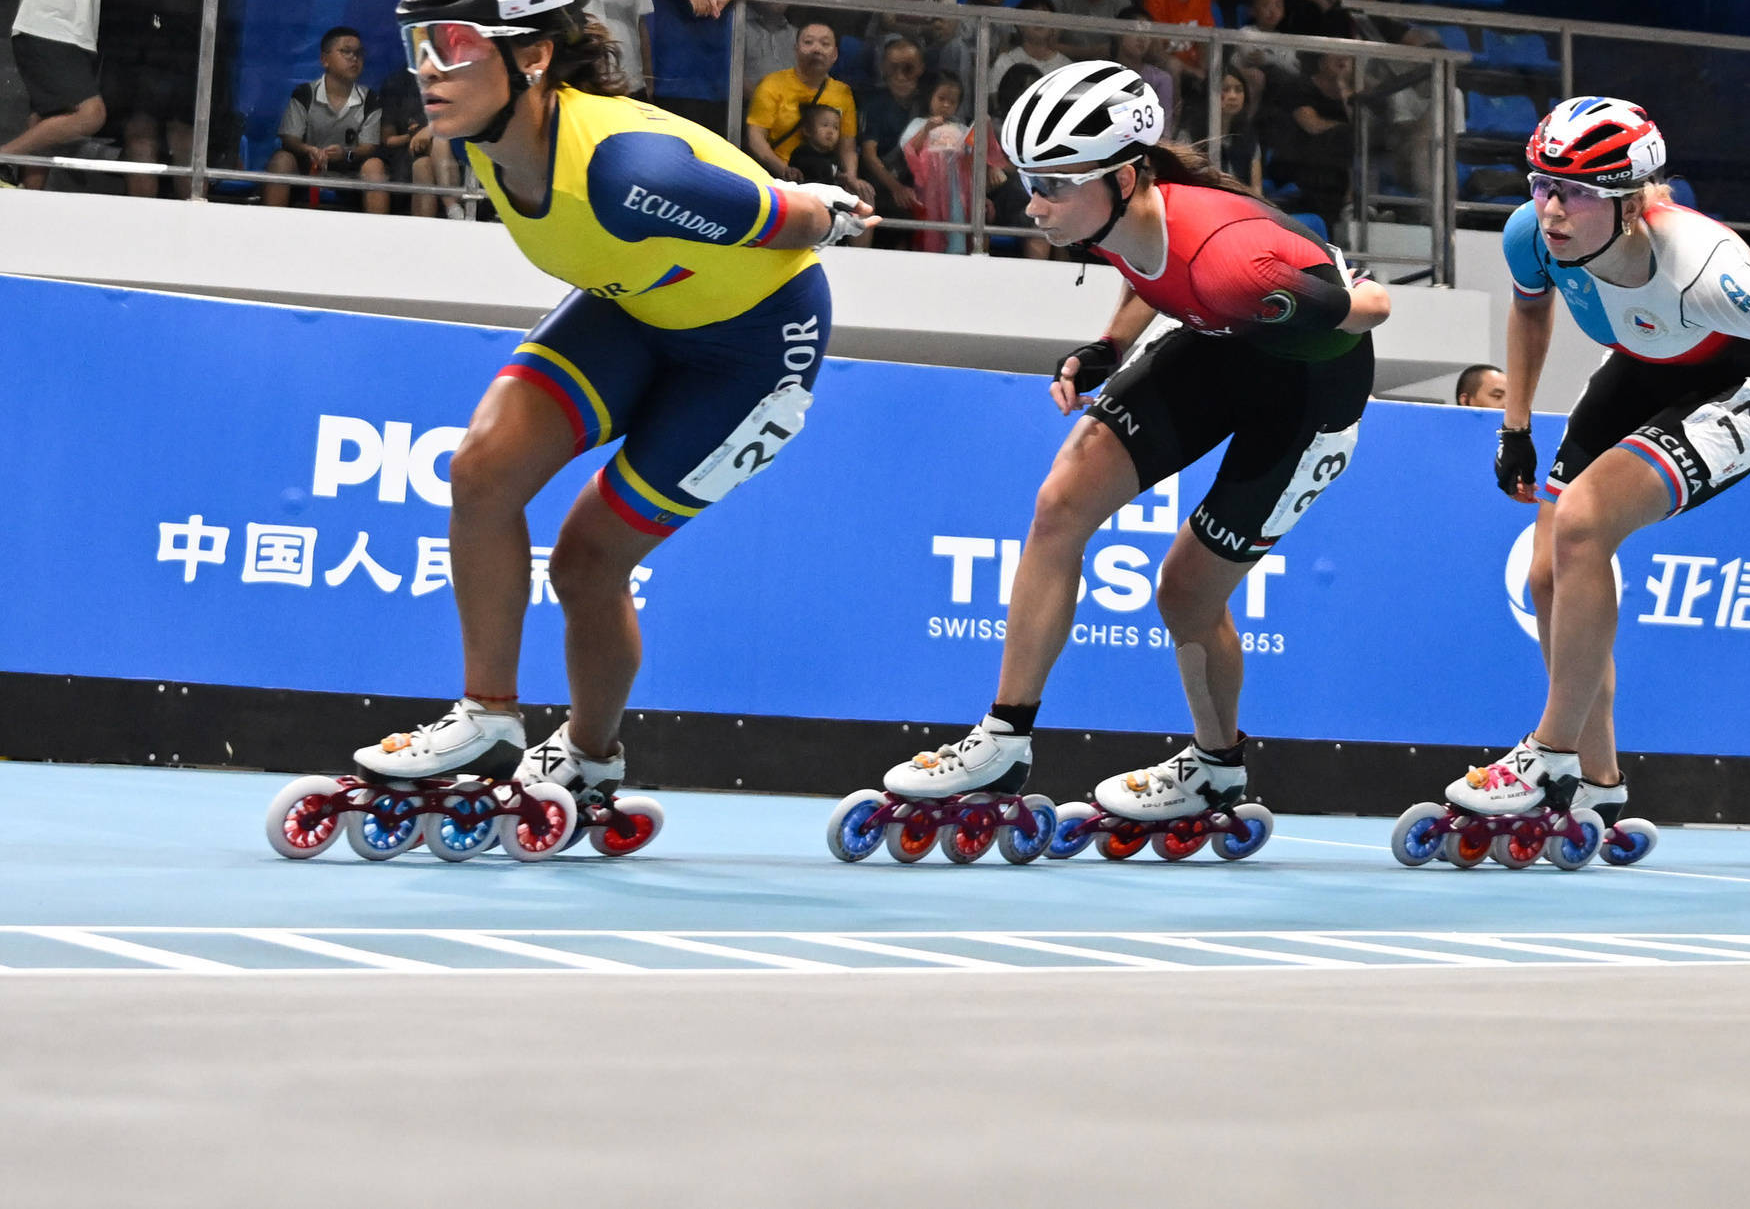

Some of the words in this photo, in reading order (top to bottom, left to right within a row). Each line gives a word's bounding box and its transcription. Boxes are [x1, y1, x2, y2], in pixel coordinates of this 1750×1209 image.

[1133, 105, 1154, 133] 33
[1596, 170, 1632, 182] RUD
[1646, 141, 1660, 166] 17
[624, 185, 728, 241] ECUADOR
[313, 414, 470, 507] PIC
[733, 420, 793, 475] 21
[1632, 424, 1704, 495] ZECHIA
[1195, 504, 1246, 552] HUN
[932, 535, 1286, 619] TIST
[928, 616, 1008, 640] SWISS
[1071, 623, 1140, 647] CHES
[1238, 631, 1285, 654] 853
